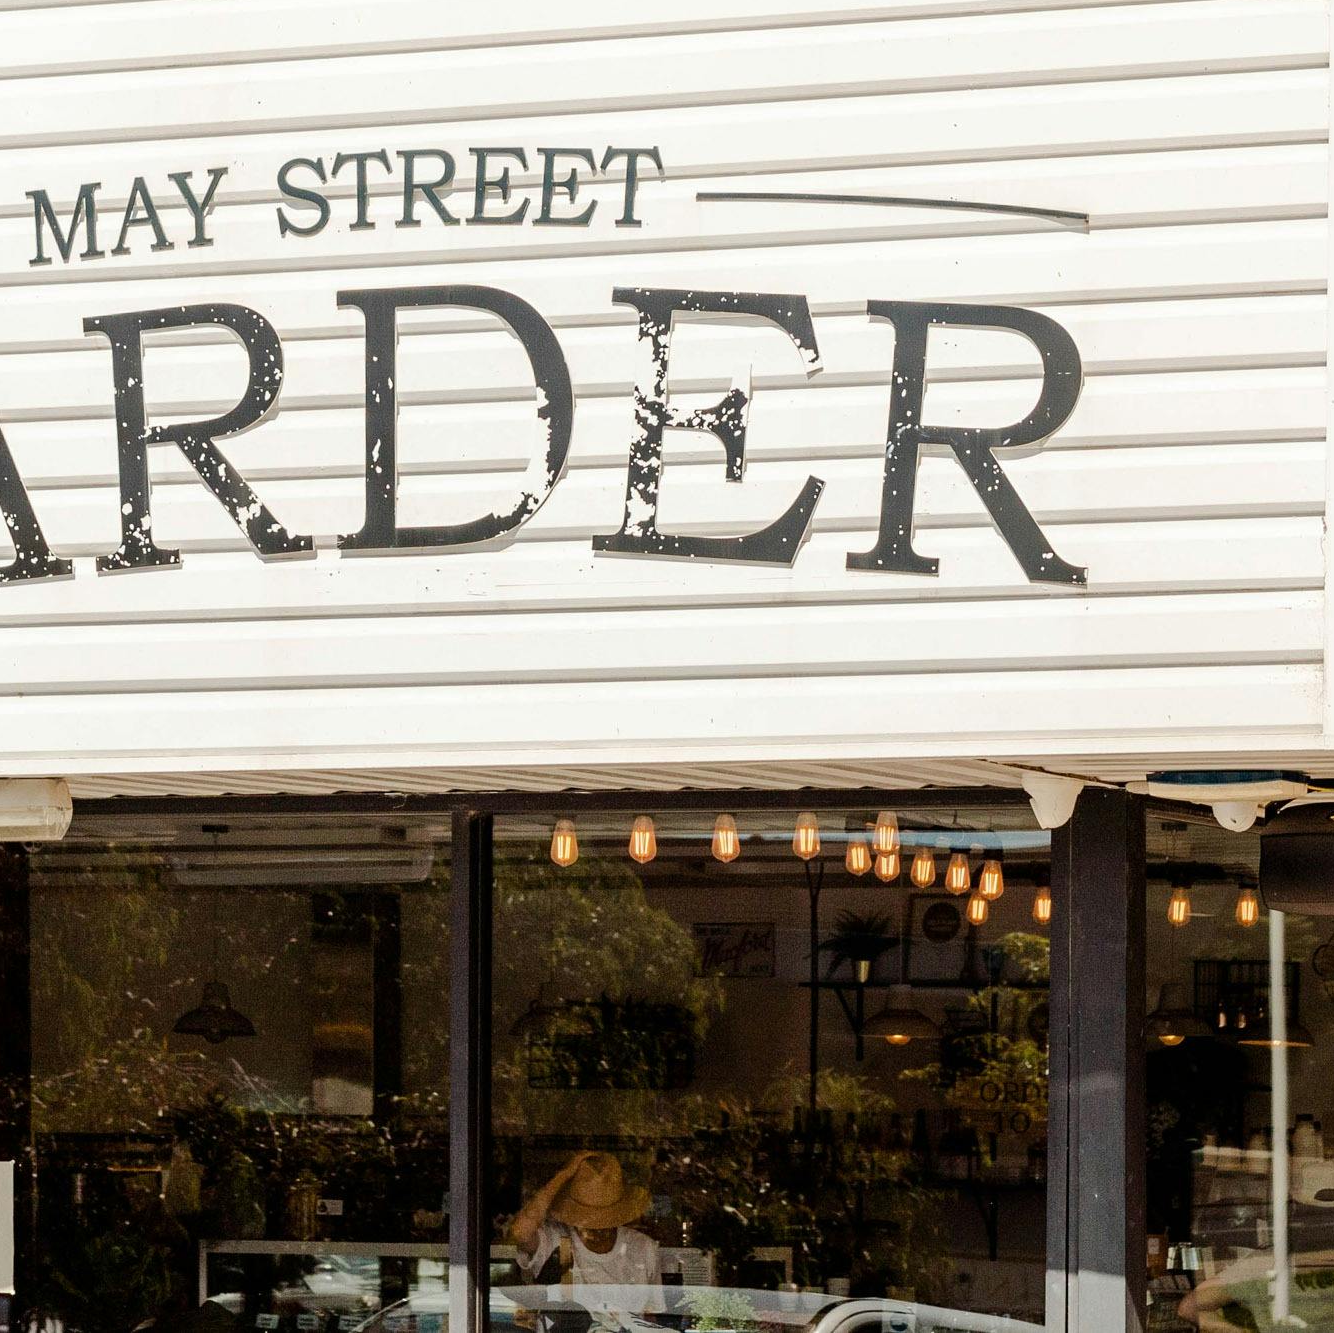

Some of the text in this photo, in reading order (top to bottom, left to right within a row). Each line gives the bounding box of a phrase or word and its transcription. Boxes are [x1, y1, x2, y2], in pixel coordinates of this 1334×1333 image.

[24, 147, 662, 266] MAY STREET
[980, 1081, 1048, 1103] ORD
